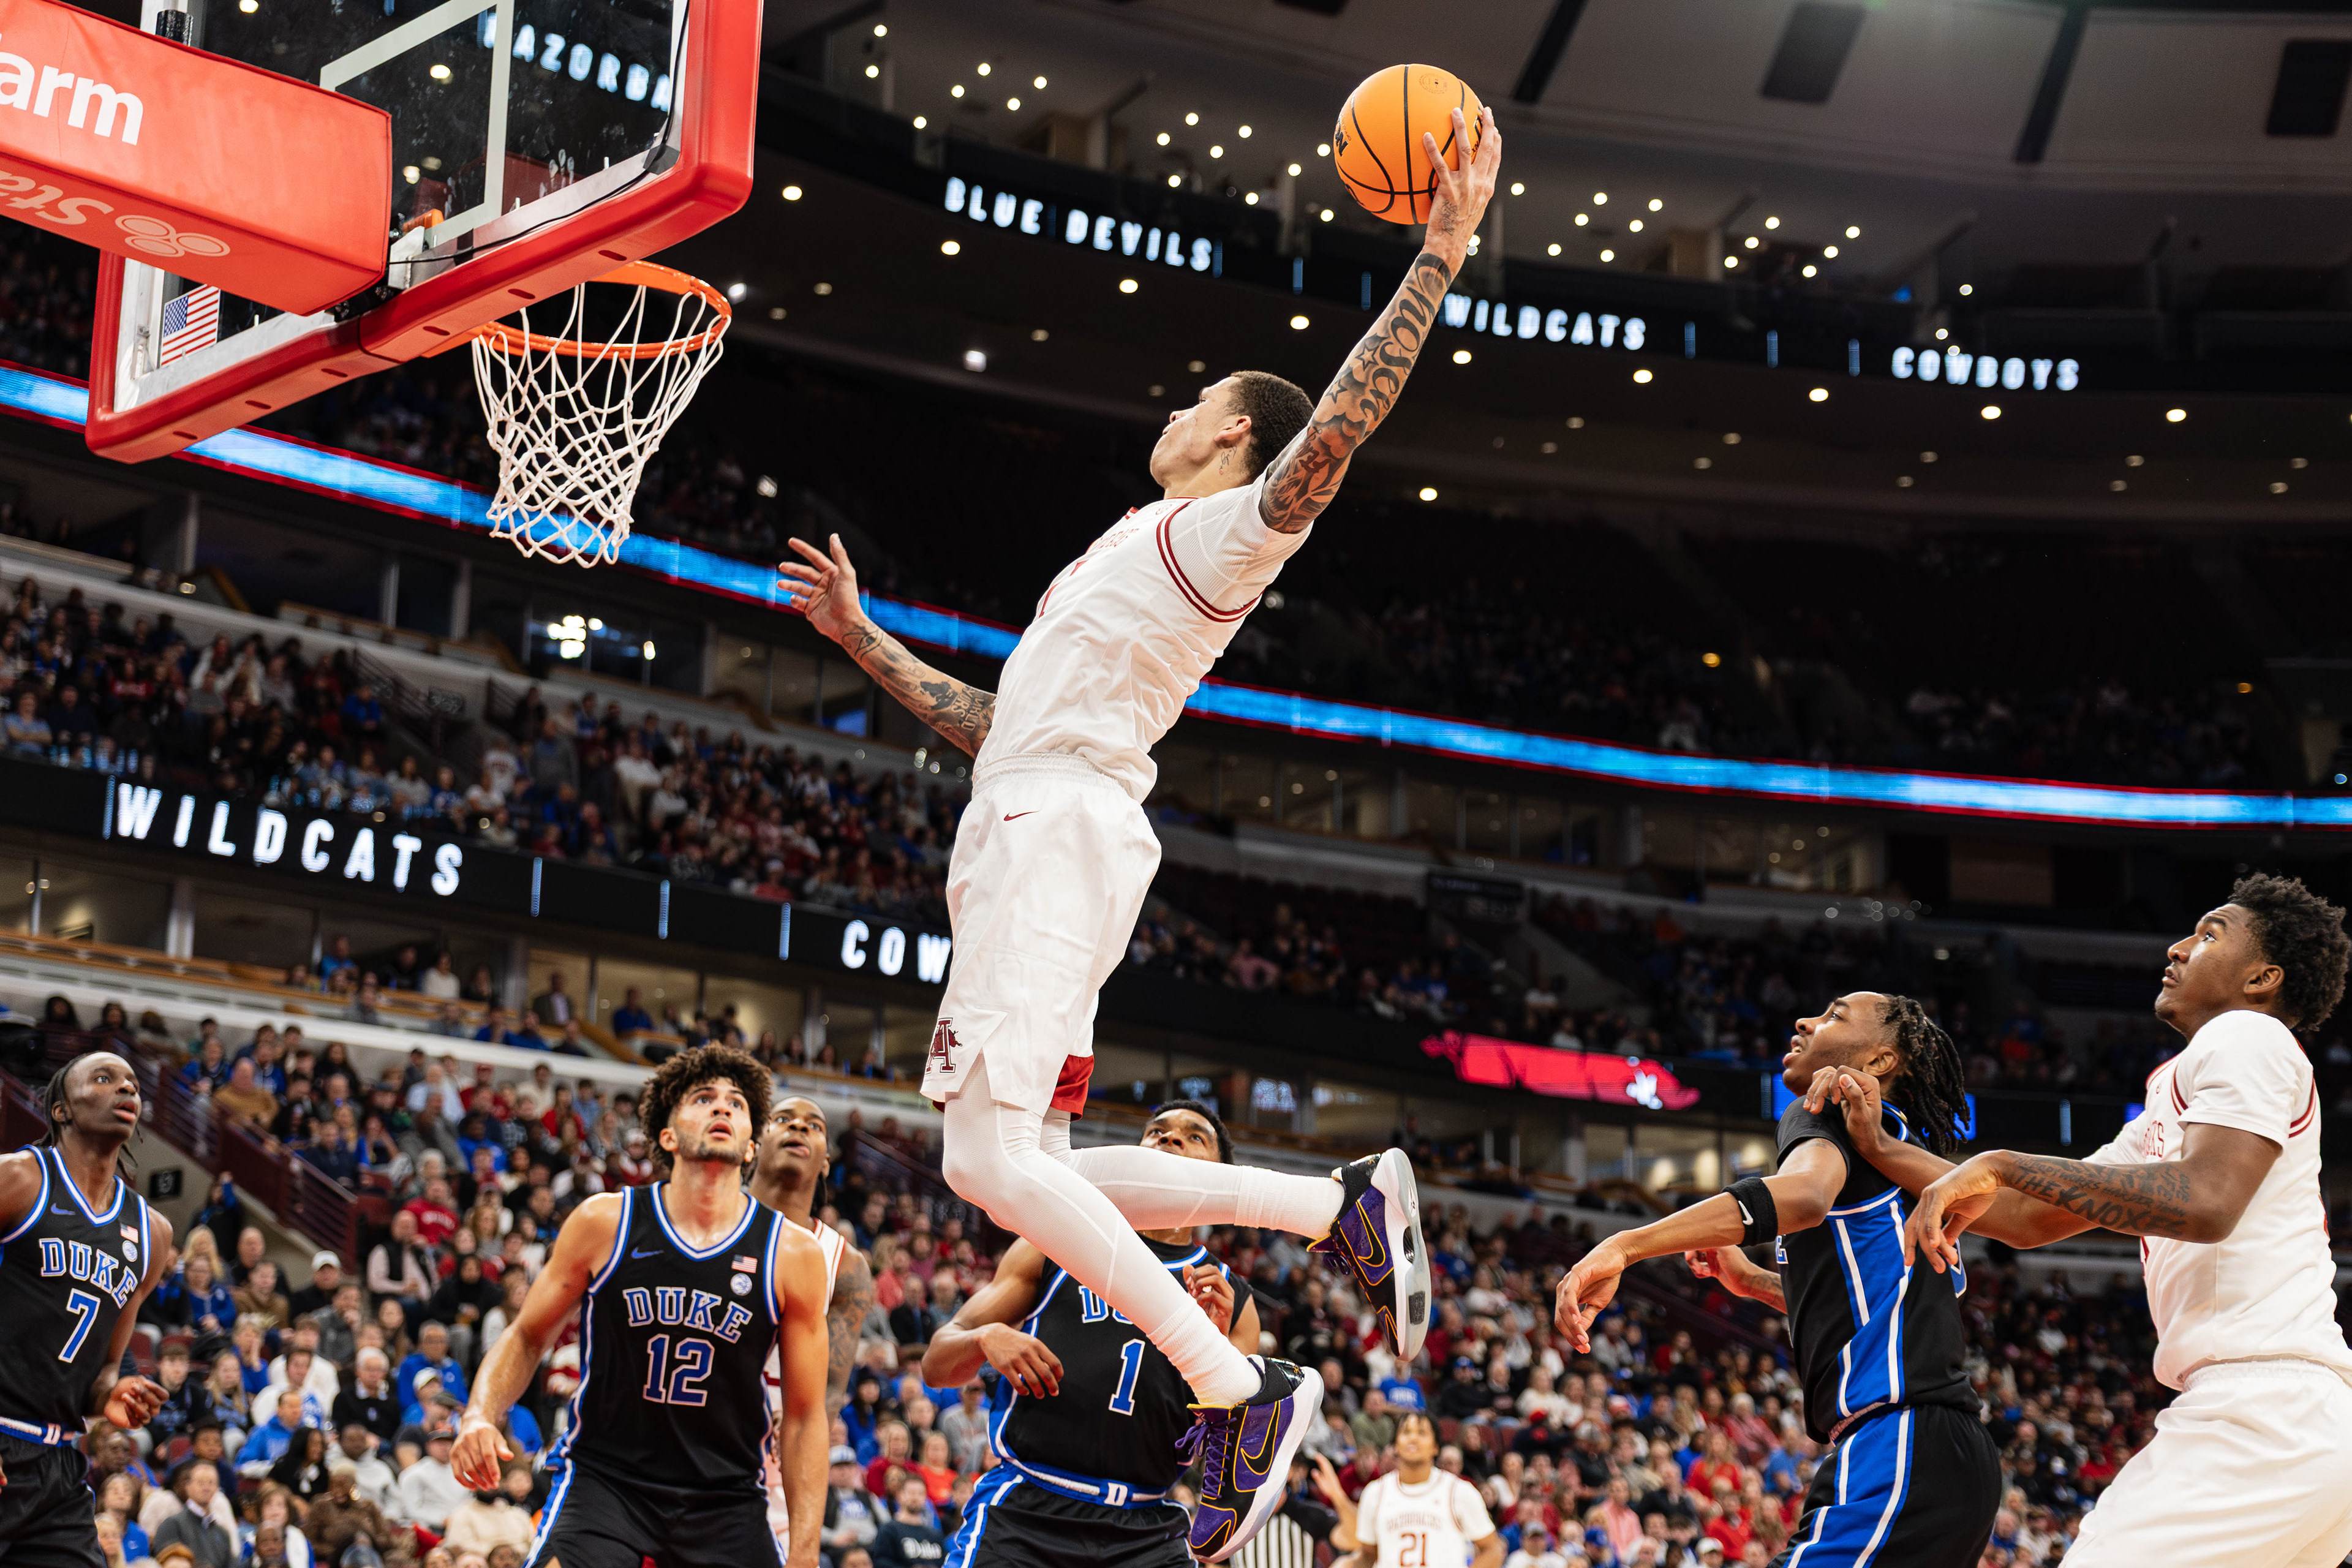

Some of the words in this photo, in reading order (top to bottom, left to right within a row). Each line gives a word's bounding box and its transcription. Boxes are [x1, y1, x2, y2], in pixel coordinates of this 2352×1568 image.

[0, 34, 143, 146] arm
[944, 176, 1044, 235] BLUE
[1065, 208, 1212, 271] DEVILS
[1442, 292, 1647, 350] WILDCATS
[1891, 346, 2079, 391] COWBOYS
[116, 782, 464, 897] WILDCATS
[840, 919, 953, 984] COW
[39, 1237, 138, 1310] DUKE
[58, 1287, 101, 1363] 7
[622, 1286, 753, 1344] DUKE
[643, 1333, 715, 1408] 12
[1108, 1338, 1146, 1417] 1
[1400, 1532, 1428, 1567] 21
